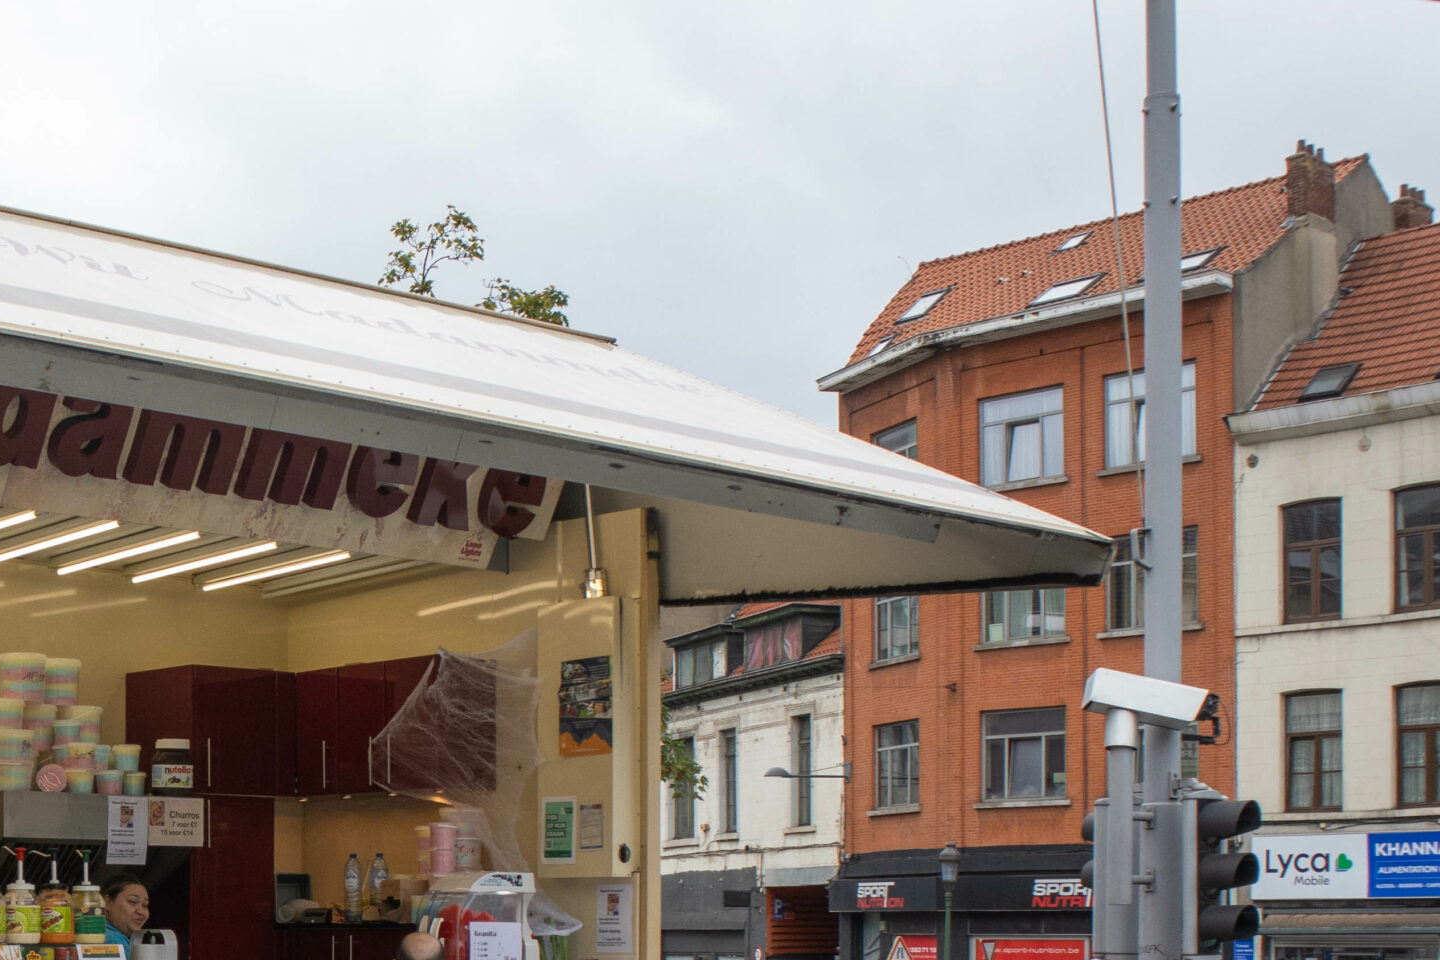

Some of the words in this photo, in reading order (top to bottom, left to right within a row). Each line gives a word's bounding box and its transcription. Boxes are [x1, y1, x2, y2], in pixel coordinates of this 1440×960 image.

[164, 766, 191, 775] nutella
[169, 810, 200, 820] Churros
[1375, 841, 1440, 857] KHANN
[1265, 849, 1330, 878] Lyca
[1294, 875, 1330, 886] Mobile
[474, 930, 498, 938] Granita
